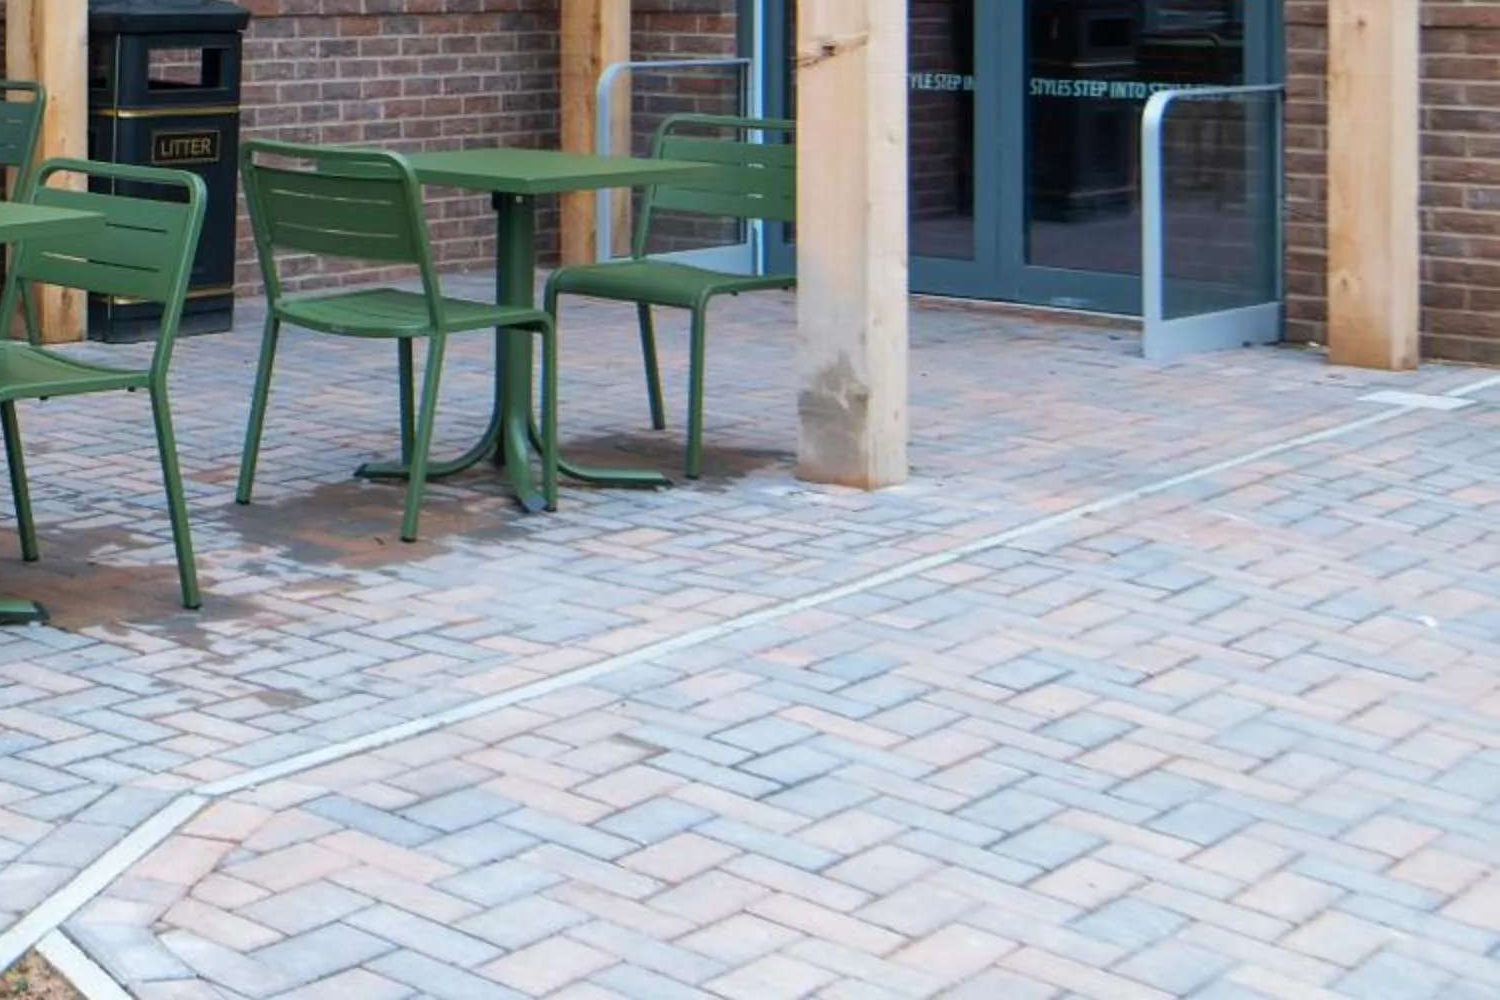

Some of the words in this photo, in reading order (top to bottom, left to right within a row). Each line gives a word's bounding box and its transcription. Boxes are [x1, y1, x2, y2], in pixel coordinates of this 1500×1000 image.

[1073, 80, 1108, 97] STEP
[1110, 81, 1146, 99] INTO
[160, 137, 211, 157] LITTER
